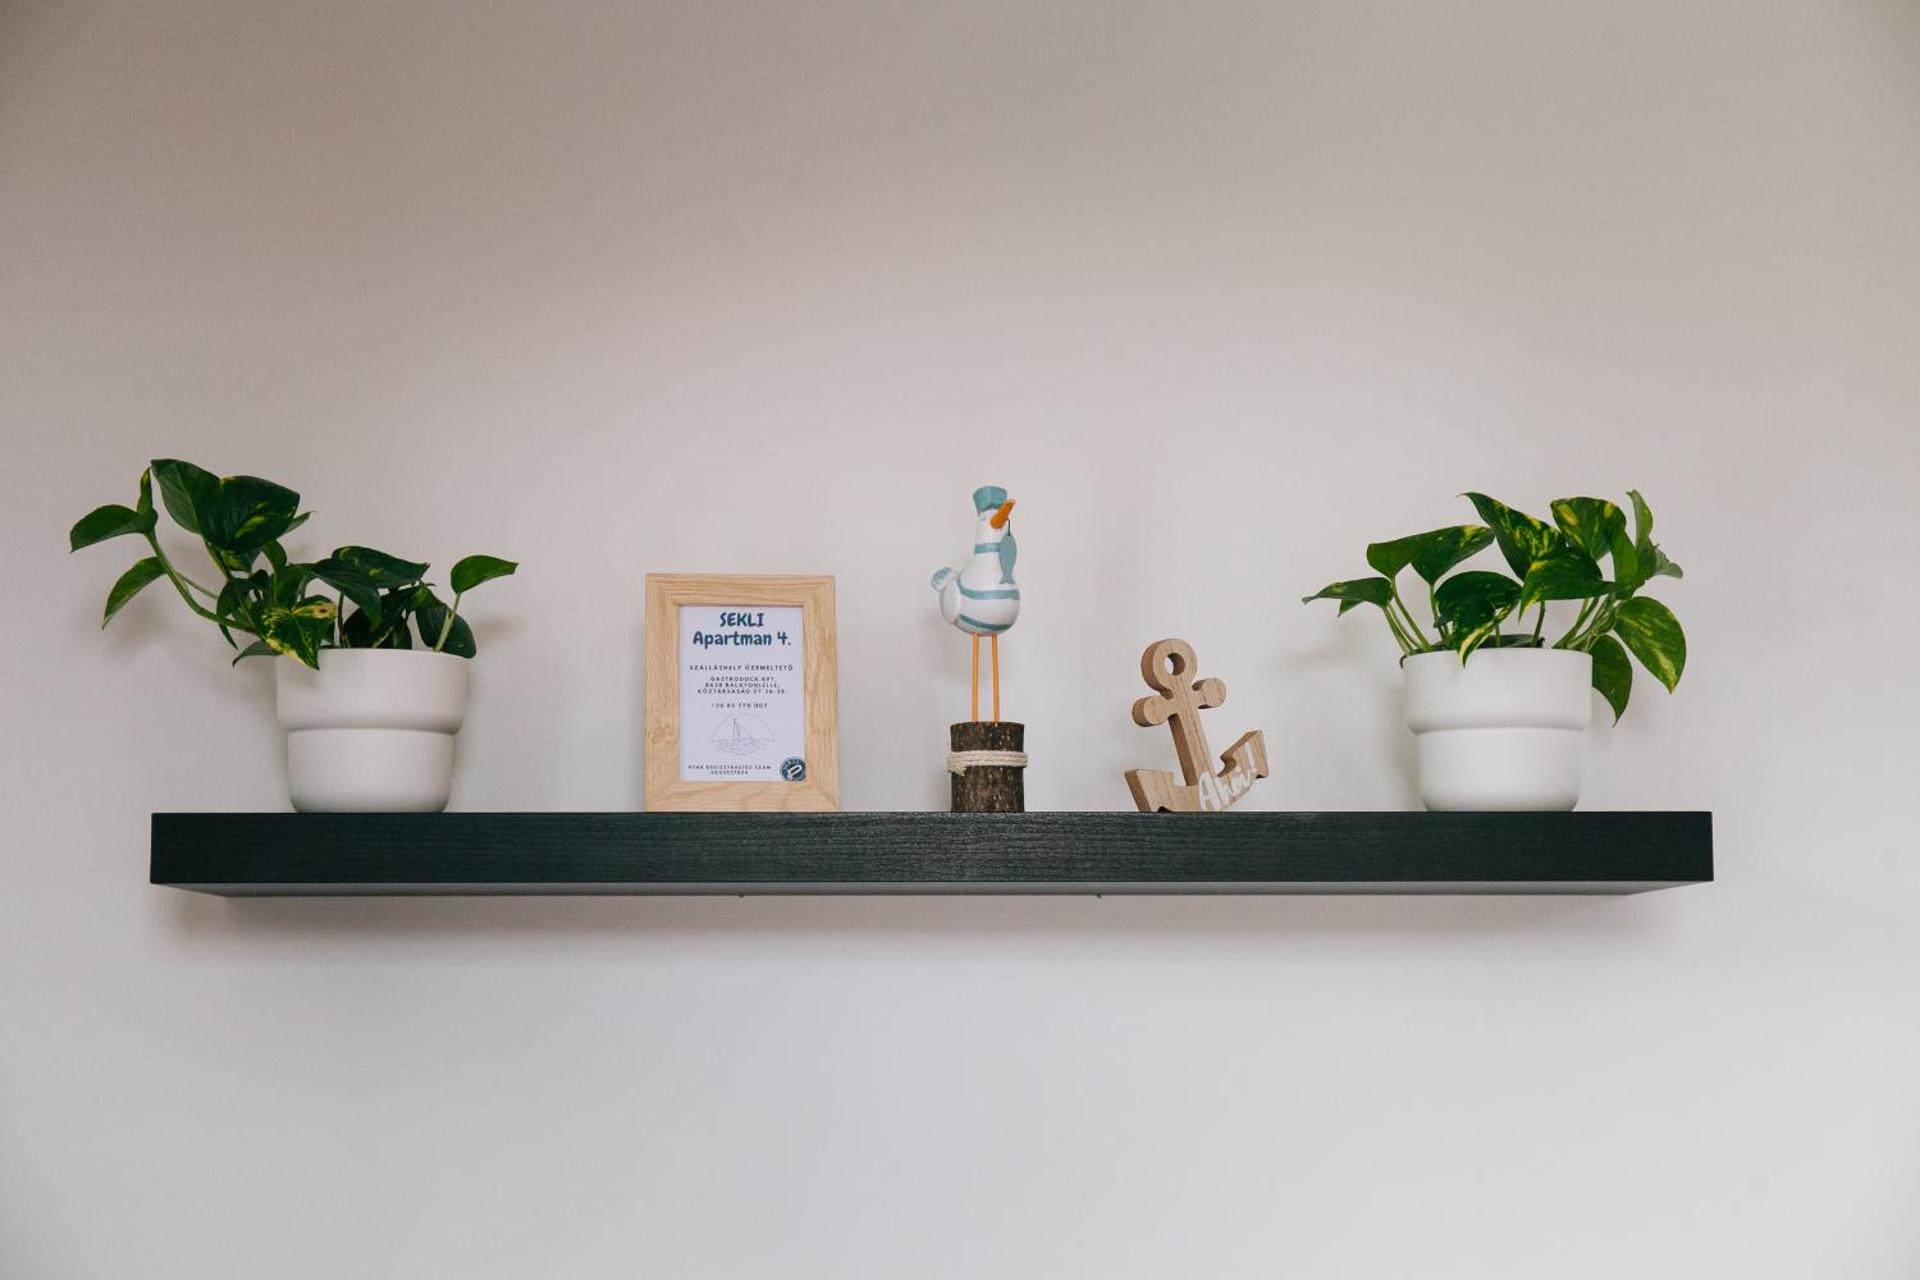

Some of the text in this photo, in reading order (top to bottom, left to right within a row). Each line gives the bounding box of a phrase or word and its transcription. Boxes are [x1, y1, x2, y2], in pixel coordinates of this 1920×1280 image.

[720, 612, 765, 627] SEKLI
[693, 630, 791, 650] Apartman 4.
